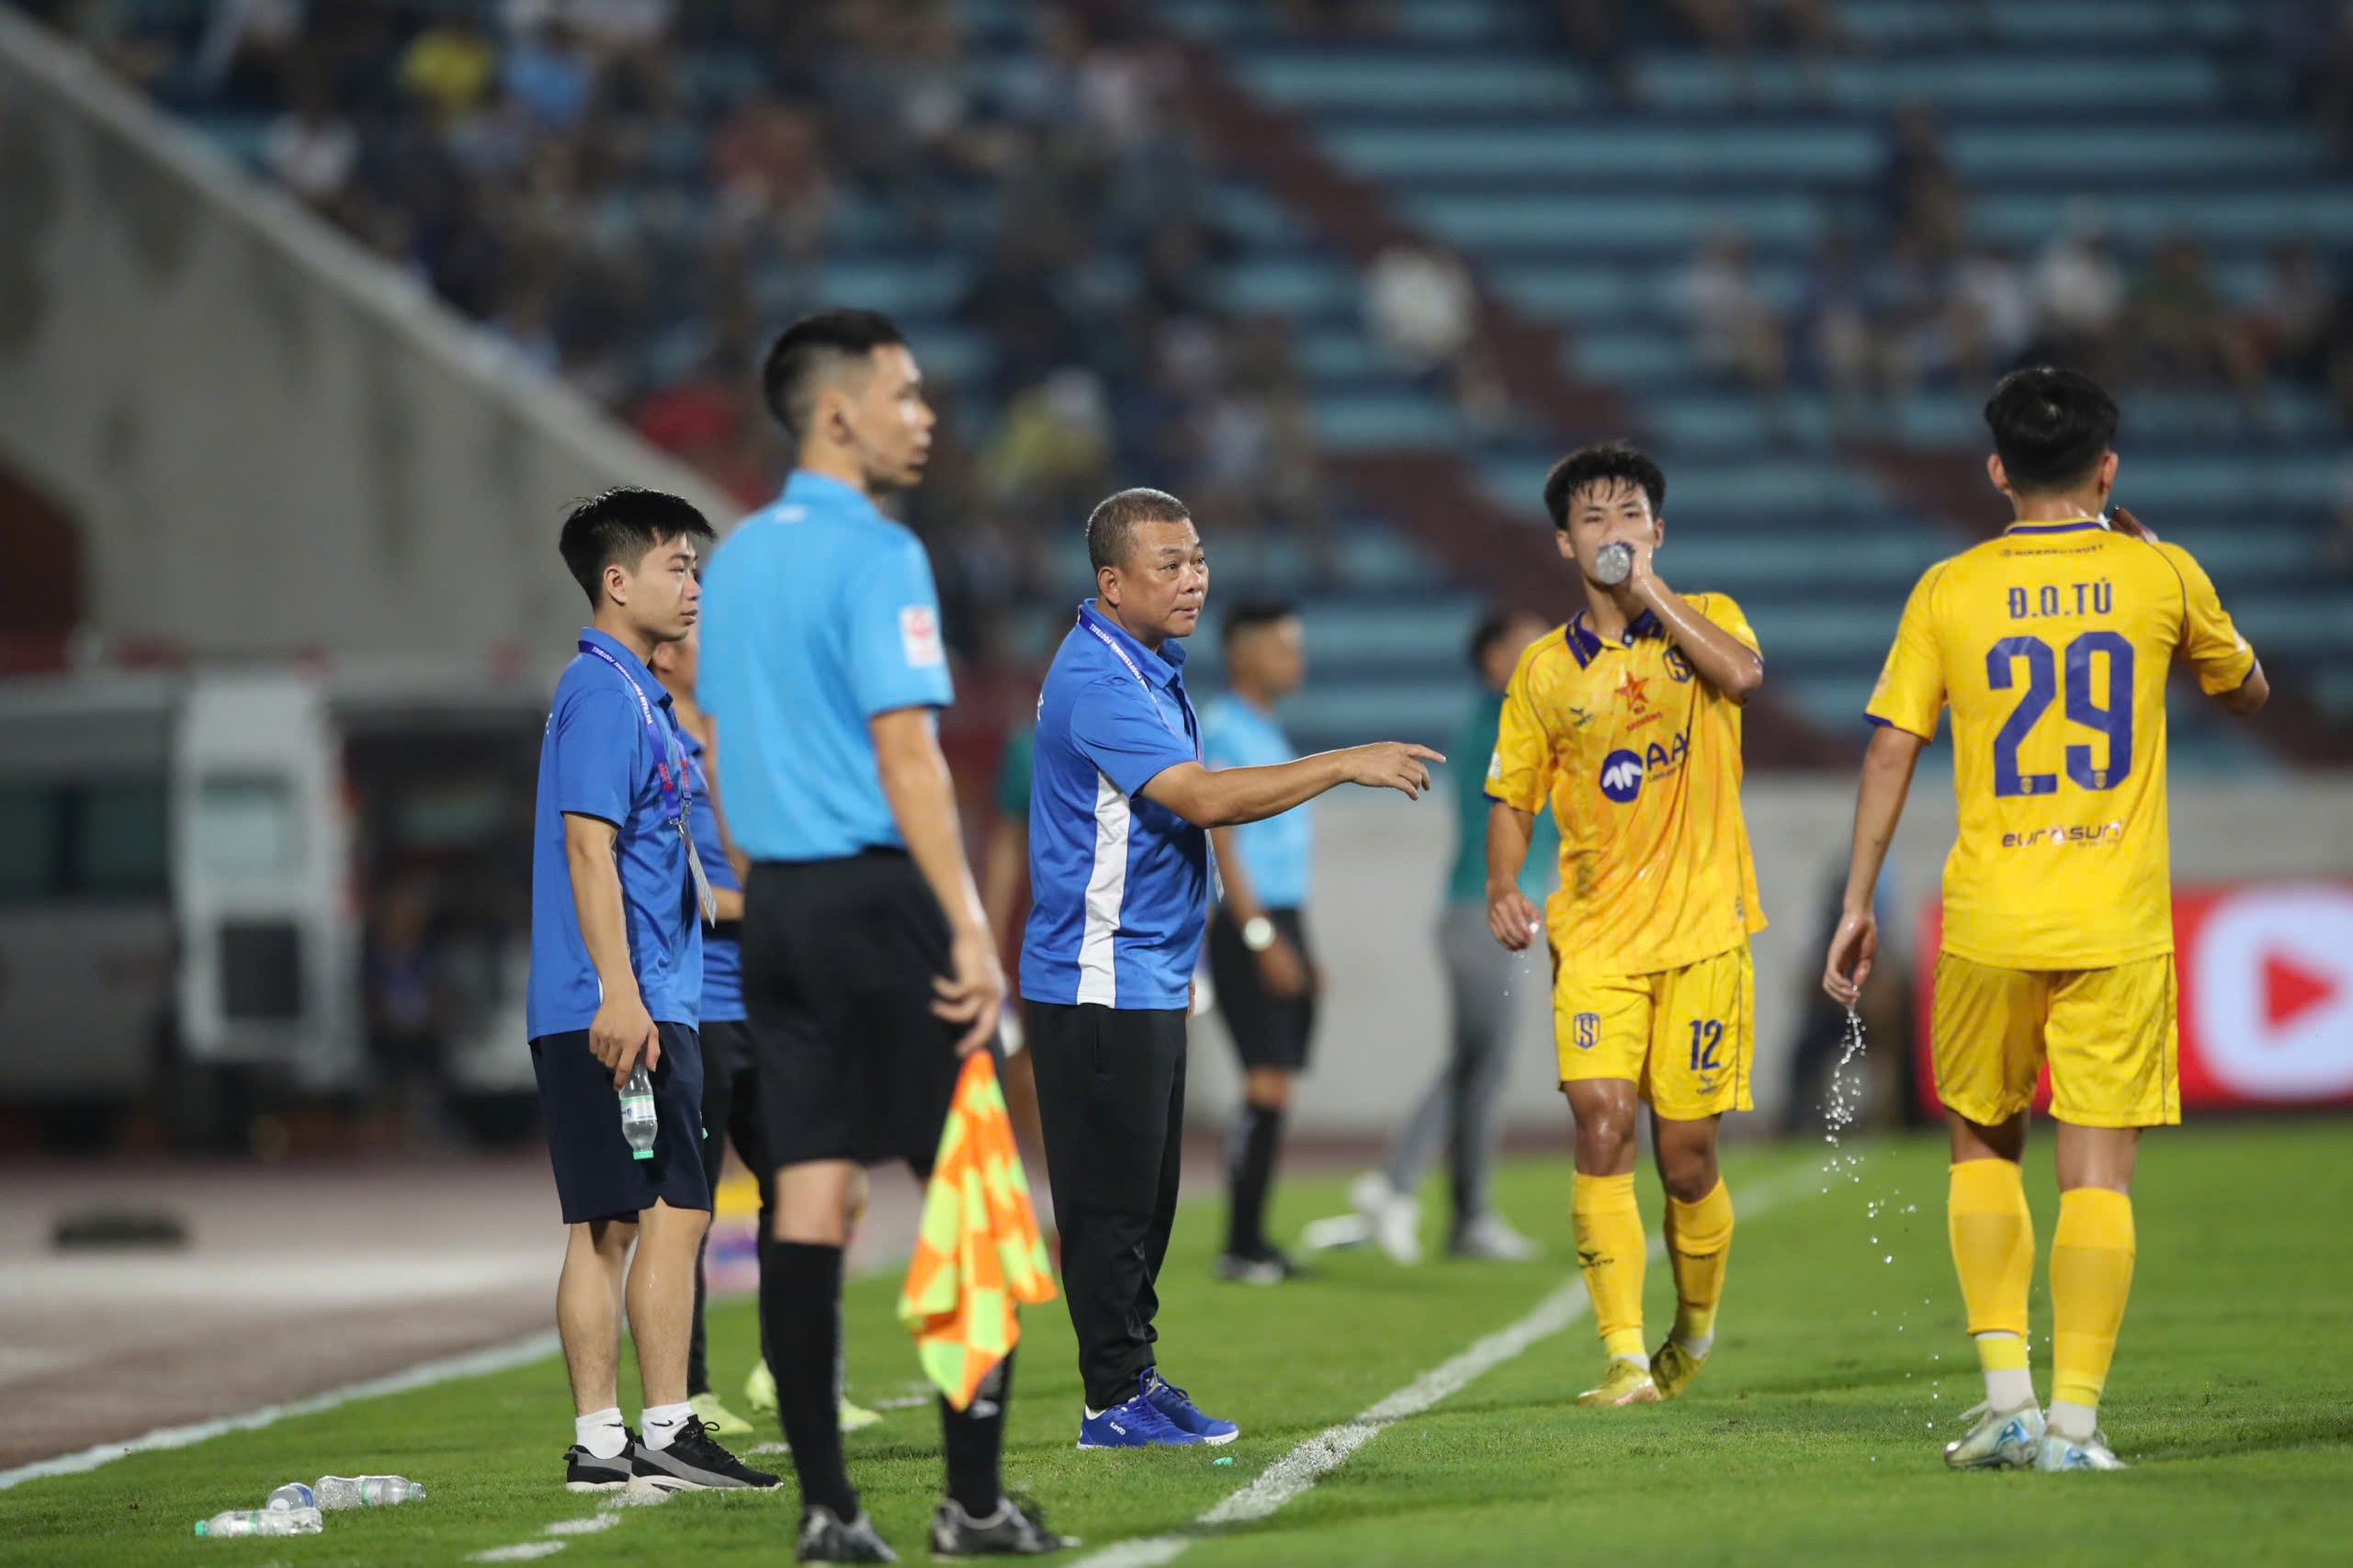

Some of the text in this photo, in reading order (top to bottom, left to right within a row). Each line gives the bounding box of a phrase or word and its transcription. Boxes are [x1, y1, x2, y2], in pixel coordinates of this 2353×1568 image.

[1089, 623, 1112, 644] FOOTBALL
[640, 695, 653, 725] VIETNAM
[1985, 631, 2133, 797] 29
[1689, 1019, 1723, 1070] 12
